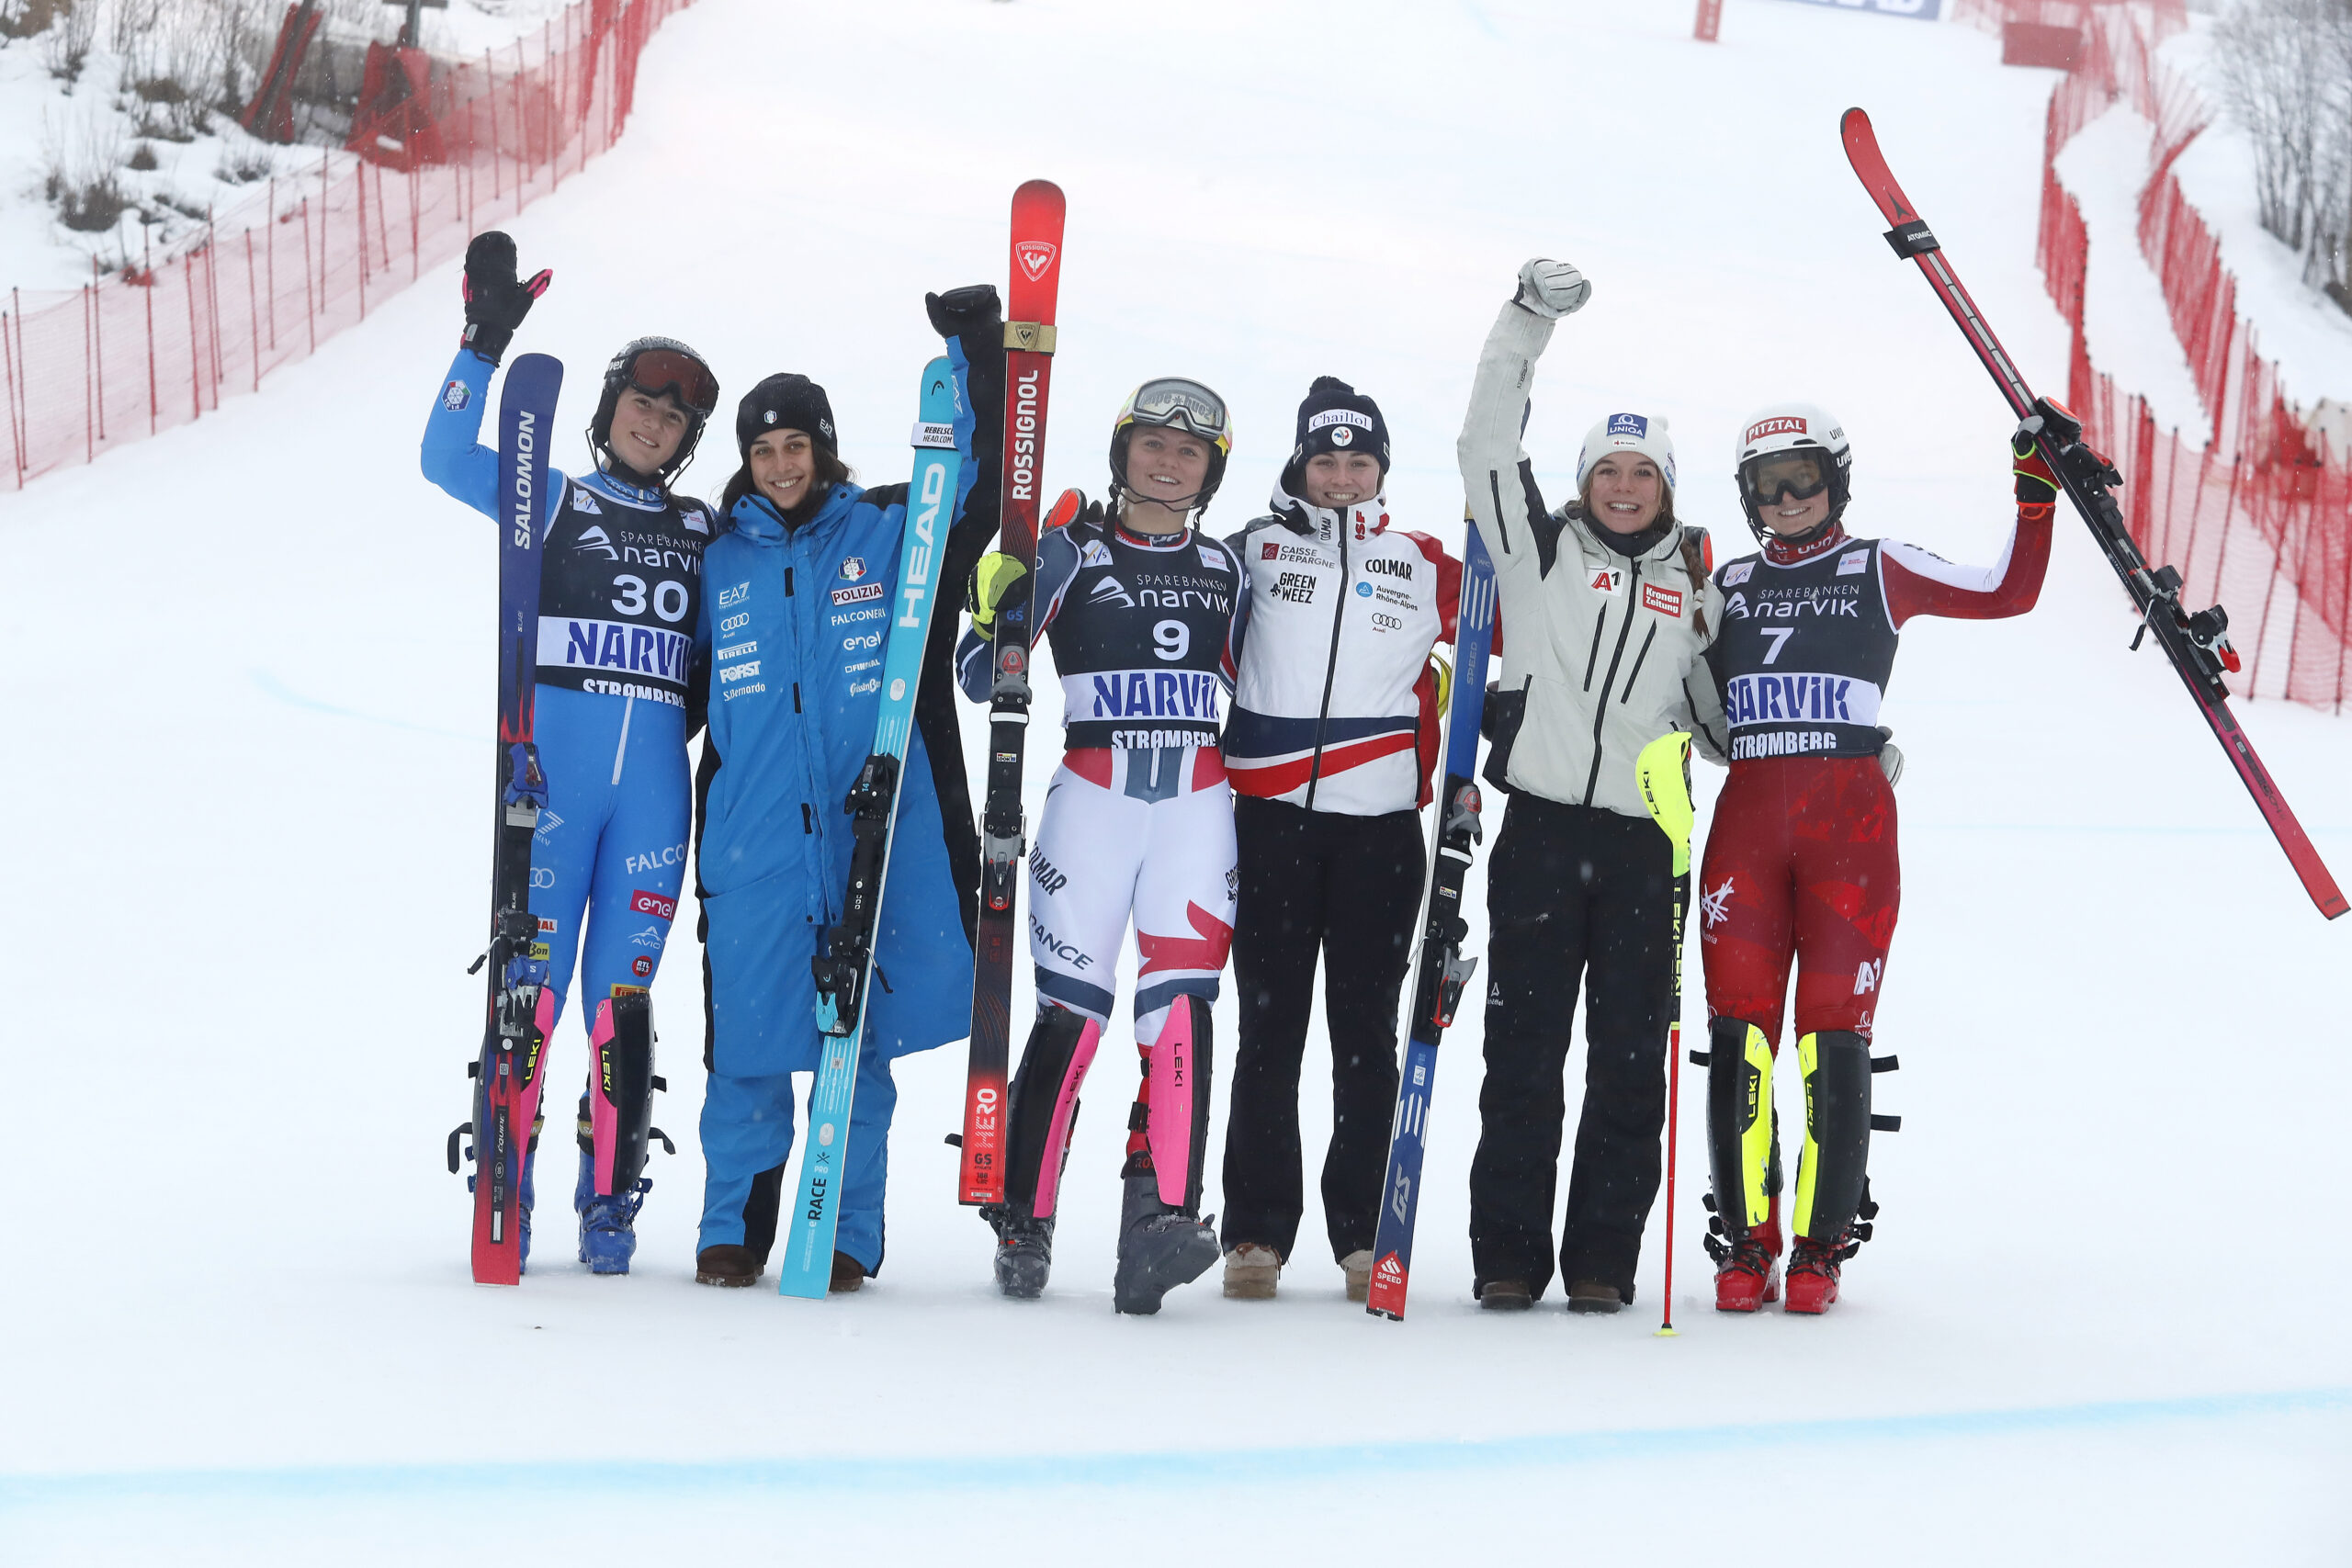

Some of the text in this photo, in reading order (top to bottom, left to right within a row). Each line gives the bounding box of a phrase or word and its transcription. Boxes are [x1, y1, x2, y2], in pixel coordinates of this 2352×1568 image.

[1906, 230, 1932, 243] ATOMIC
[1021, 244, 1050, 253] ROSSIGNOL
[1312, 412, 1367, 427] Chaillol
[1748, 419, 1803, 441] PITZTAL
[922, 434, 953, 444] HEAD.COM
[1012, 369, 1038, 501] ROSSIGNOL
[1609, 425, 1644, 436] UNIQA
[1837, 452, 1852, 468] uve
[514, 410, 536, 550] SALOMON
[620, 530, 705, 554] SPAREBANKE
[899, 462, 945, 628] HEAD
[1281, 546, 1317, 557] CAISSE
[1279, 553, 1335, 570] D'EPARGNE
[1365, 558, 1412, 581] COLMAR
[1136, 573, 1227, 592] SPAREBANKEN
[1279, 571, 1317, 591] GREEN
[1591, 570, 1621, 592] A1
[1760, 584, 1860, 599] SPAREBANKEN
[611, 574, 689, 623] 30
[719, 581, 750, 605] EA7
[832, 584, 882, 604] POLIZIA
[1139, 589, 1230, 616] narvik
[1282, 586, 1314, 604] WEEZ
[1375, 584, 1412, 601] Auvergne-
[1375, 593, 1419, 611] Rhône-Alpes
[1645, 586, 1679, 604] Kronen
[1006, 609, 1024, 622] GS
[1645, 596, 1679, 614] Zeitung
[1754, 598, 1859, 618] narvik
[831, 608, 886, 626] FALCONERI
[1152, 619, 1190, 661] 9
[1372, 626, 1386, 634] Audi
[718, 641, 757, 660] PIRELLI
[842, 631, 881, 651] enel
[1759, 626, 1794, 665] 7
[719, 660, 761, 683] FORST
[1467, 641, 1477, 685] SPEED
[1731, 731, 1837, 760] STRØMBERG
[1643, 770, 1659, 816] LEKI
[638, 897, 674, 919] enel
[1673, 886, 1681, 940] LEKI
[631, 938, 662, 950] AVIO
[1029, 910, 1093, 970] RANCE
[525, 1039, 541, 1080] LEKI
[1174, 1043, 1182, 1088] LEKI
[602, 1050, 611, 1091] LEKI
[1066, 1065, 1084, 1104] LEKI
[1748, 1075, 1758, 1119] LEKI
[1805, 1082, 1814, 1128] LEKI
[975, 1088, 998, 1148] HERO
[814, 1165, 829, 1174] PRO
[974, 1153, 992, 1165] GS
[1391, 1162, 1410, 1226] GS
[1376, 1271, 1402, 1284] SPEED
